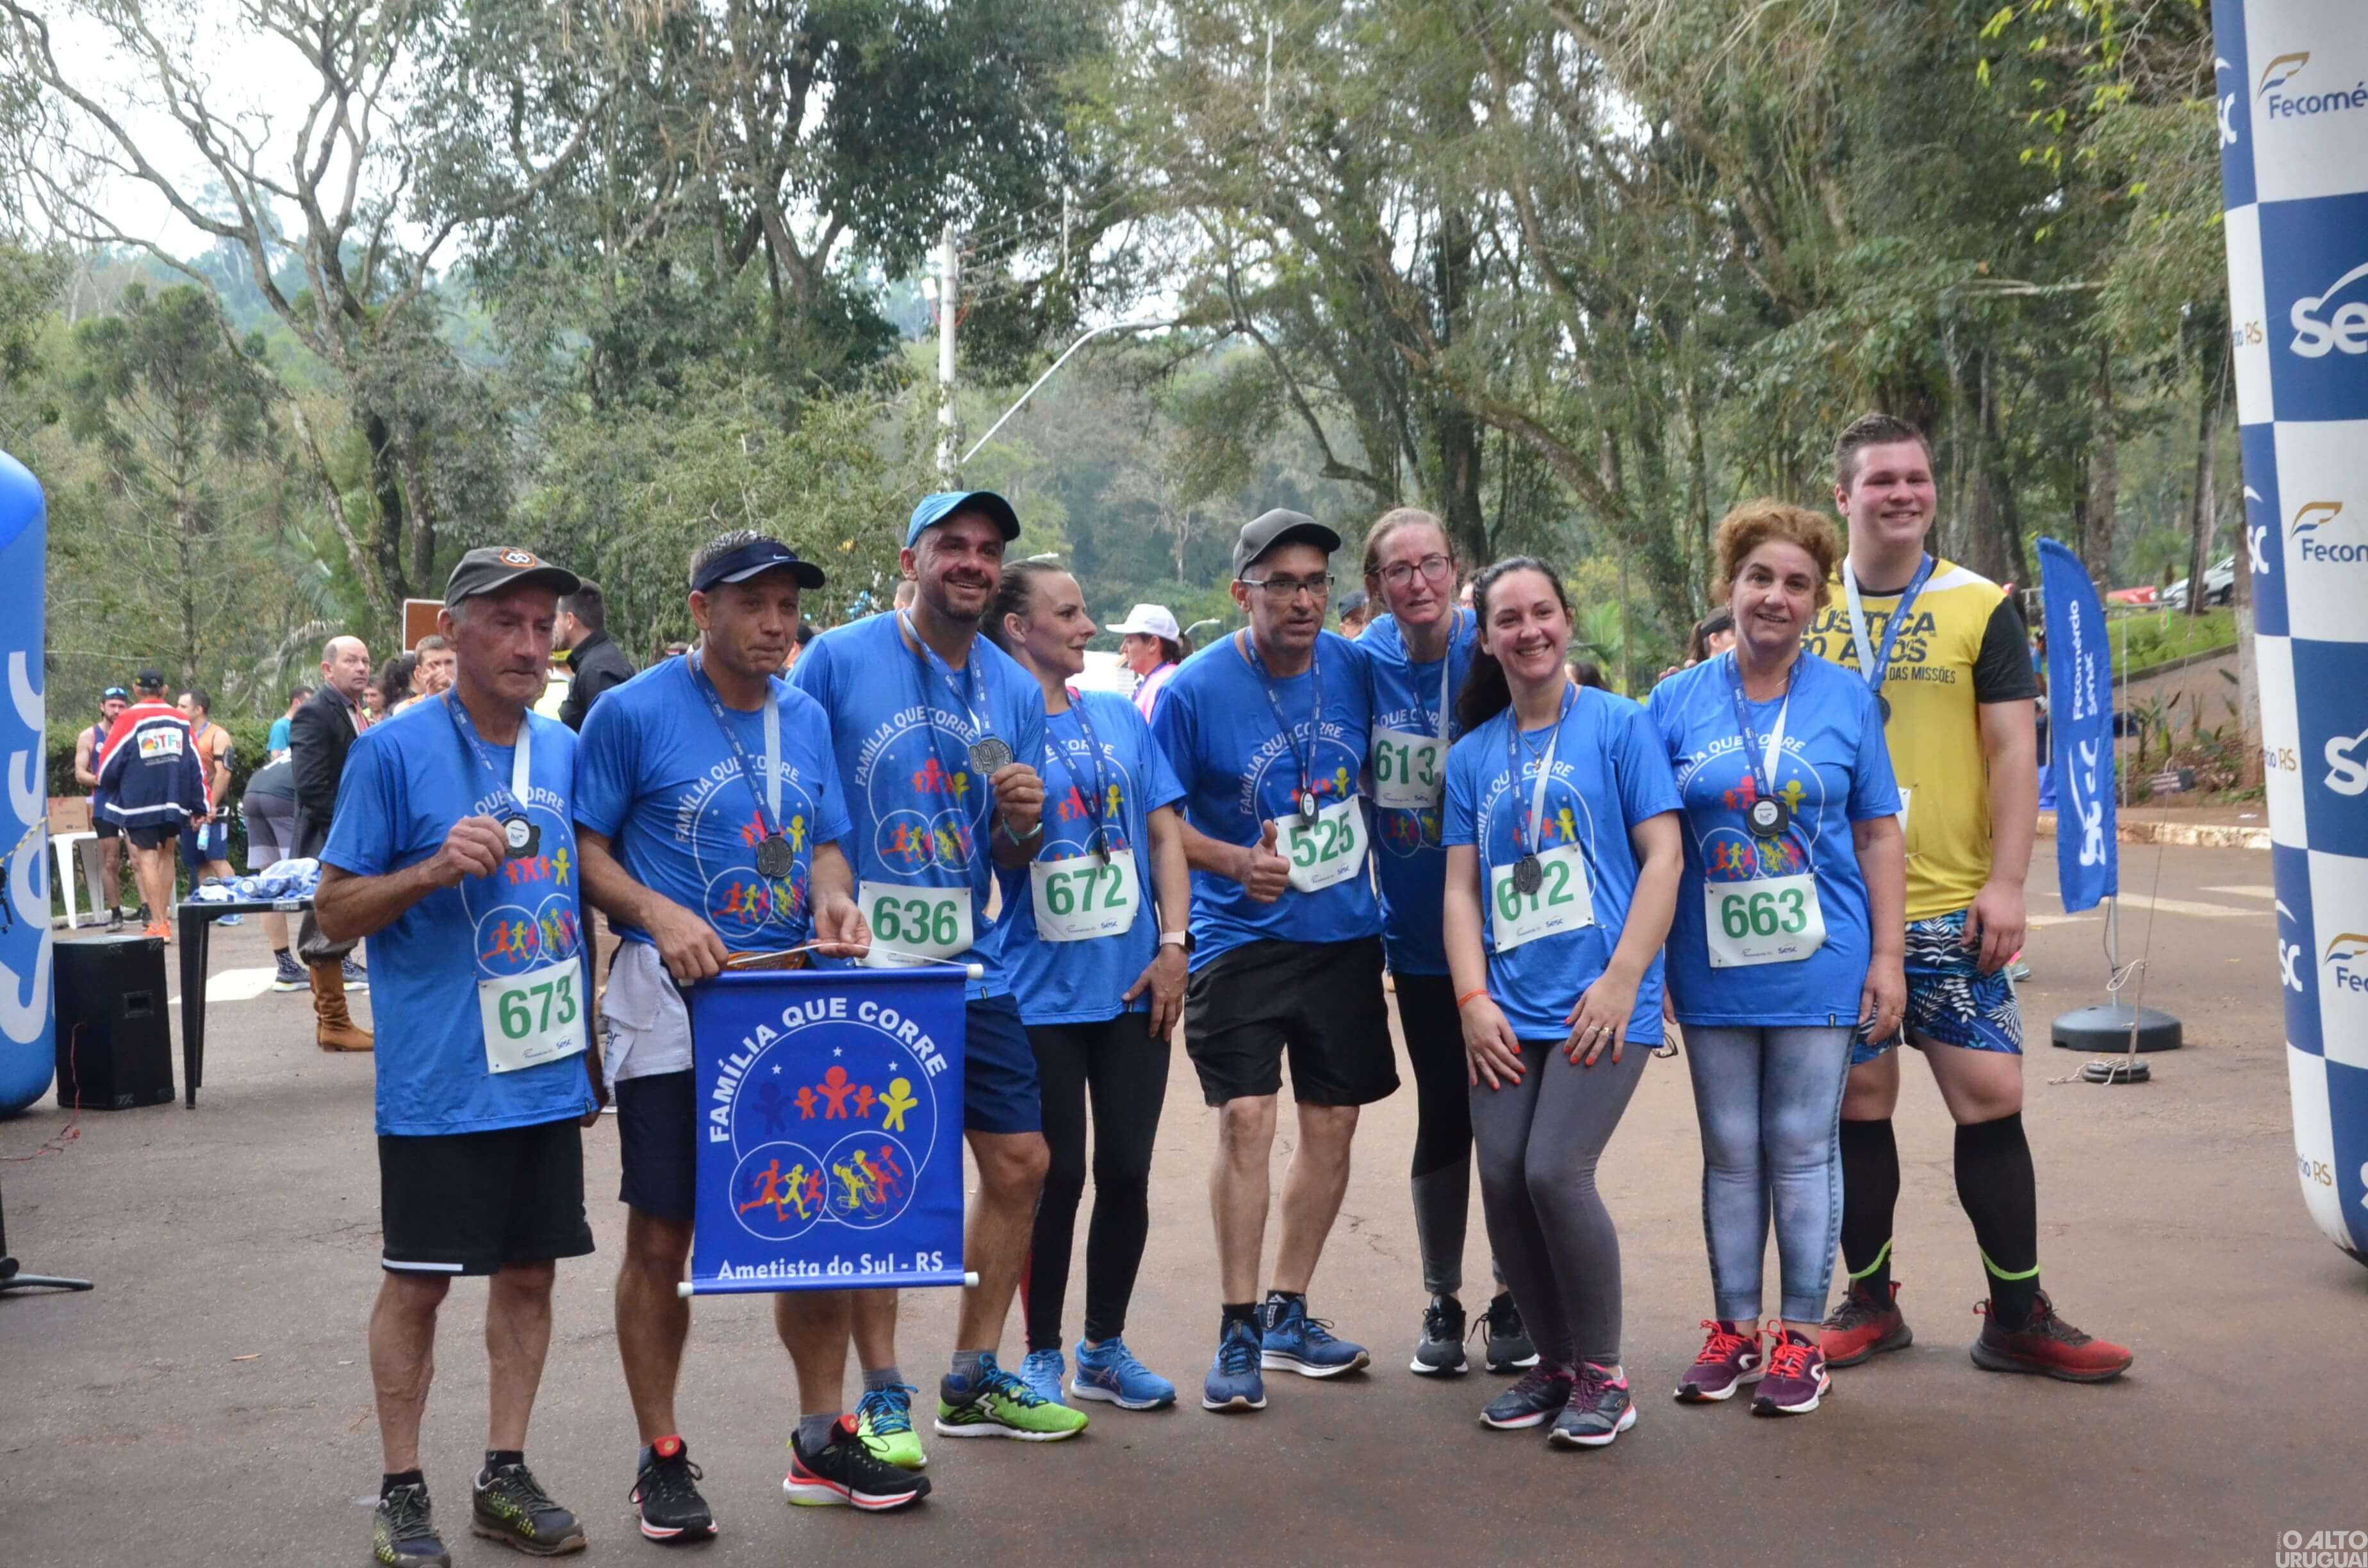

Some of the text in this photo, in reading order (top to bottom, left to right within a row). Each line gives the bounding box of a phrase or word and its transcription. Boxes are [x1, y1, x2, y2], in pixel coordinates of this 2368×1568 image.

[2244, 321, 2263, 345] RS
[1889, 666, 1909, 681] DAS
[1911, 666, 1956, 685] MISSÕES
[1381, 709, 1408, 728] QUE
[855, 723, 894, 787] FAMÍLIA
[894, 706, 926, 728] QUE
[1376, 739, 1436, 787] 613
[2278, 748, 2297, 772] RS
[675, 776, 714, 844] FAMÍLIA
[1240, 755, 1266, 815] FAMÍLIA
[1289, 810, 1355, 867] 525
[1046, 864, 1128, 916] 672
[1721, 888, 1807, 939] 663
[872, 896, 958, 945] 636
[498, 974, 577, 1040] 673
[709, 997, 948, 1143] FAMÍLIA QUE CORRE
[2313, 1160, 2332, 1187] RS
[717, 1259, 821, 1281] Ametista
[826, 1254, 853, 1277] do
[860, 1254, 894, 1274] Sul
[916, 1251, 944, 1273] RS
